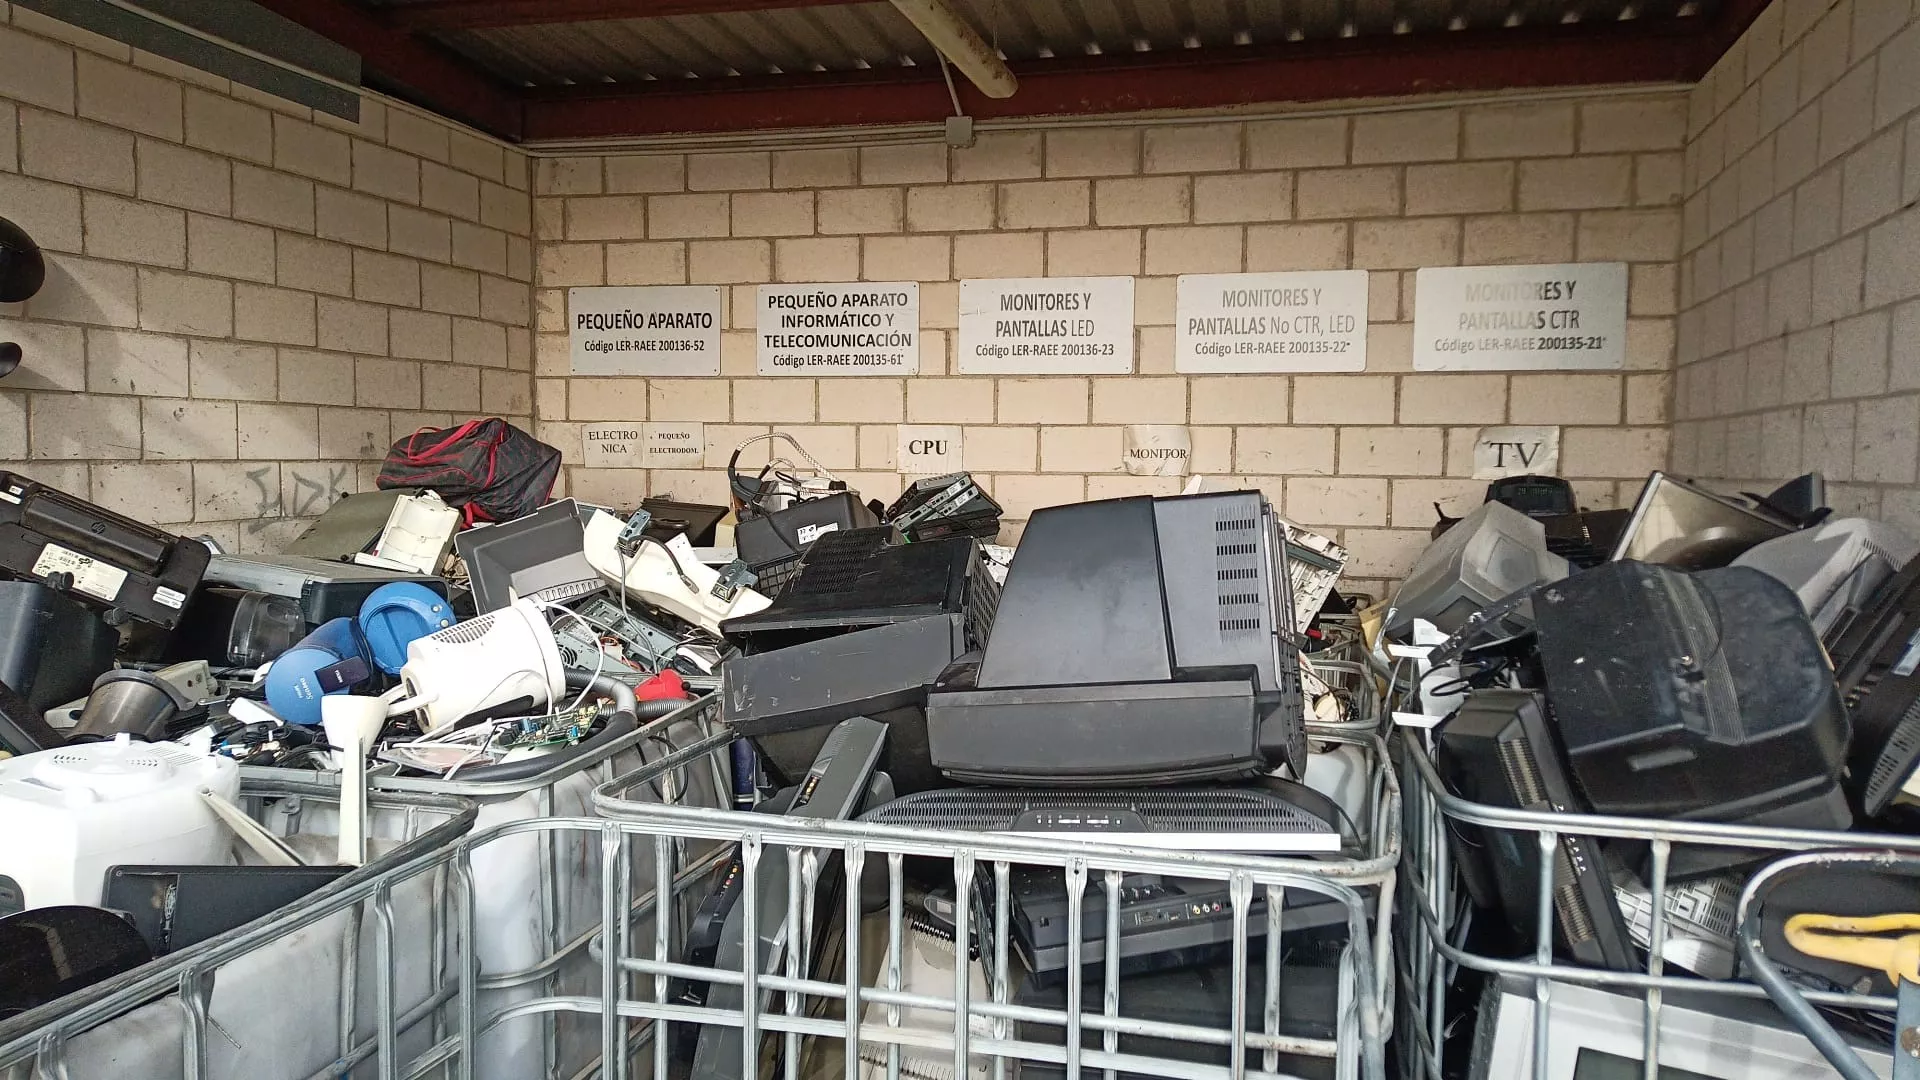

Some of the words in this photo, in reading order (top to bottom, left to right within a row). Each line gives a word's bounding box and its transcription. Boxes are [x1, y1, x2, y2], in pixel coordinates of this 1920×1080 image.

[1222, 288, 1309, 308] MONITORES
[1312, 288, 1322, 305] Y
[1465, 281, 1562, 302] MONITORES
[1566, 280, 1576, 300] Y
[768, 291, 837, 310] PEQUEÑO
[841, 293, 908, 308] APARATO
[1000, 293, 1080, 311] MONITORES
[1083, 293, 1092, 310] Y
[577, 309, 644, 331] PEQUEÑO
[648, 312, 713, 329] APARATO
[781, 311, 881, 328] INFORMÁTICO
[885, 313, 895, 326] Y
[996, 320, 1068, 337] PANTALLAS
[1071, 319, 1095, 337] LED
[1188, 317, 1266, 336] PANTALLAS
[1270, 316, 1290, 335] No
[1294, 316, 1324, 337] CTR,
[1329, 315, 1355, 333] LED
[1459, 310, 1546, 331] PANTALLAS
[1551, 310, 1580, 329] CTR
[584, 340, 614, 354] Código
[616, 340, 656, 351] LER-RAEE
[658, 340, 705, 351] 200136-52
[764, 330, 912, 348] TELECOMUNICACIÓN
[1435, 336, 1475, 354] Código
[1478, 338, 1536, 351] LER-RAEE
[976, 344, 1010, 359] Código
[1012, 344, 1059, 356] LER-RAEE
[1061, 344, 1115, 356] 200136-23
[1195, 342, 1232, 357] Código
[1234, 342, 1285, 354] LER-RAEE
[773, 355, 805, 369] Código
[807, 355, 850, 366] LER-RAEE
[588, 430, 638, 440] ELECTRO
[658, 431, 690, 440] PEQUEÑO
[601, 443, 628, 454] NICA
[908, 439, 948, 456] CPU
[1130, 448, 1187, 459] MONITOR
[1489, 442, 1542, 468] TV
